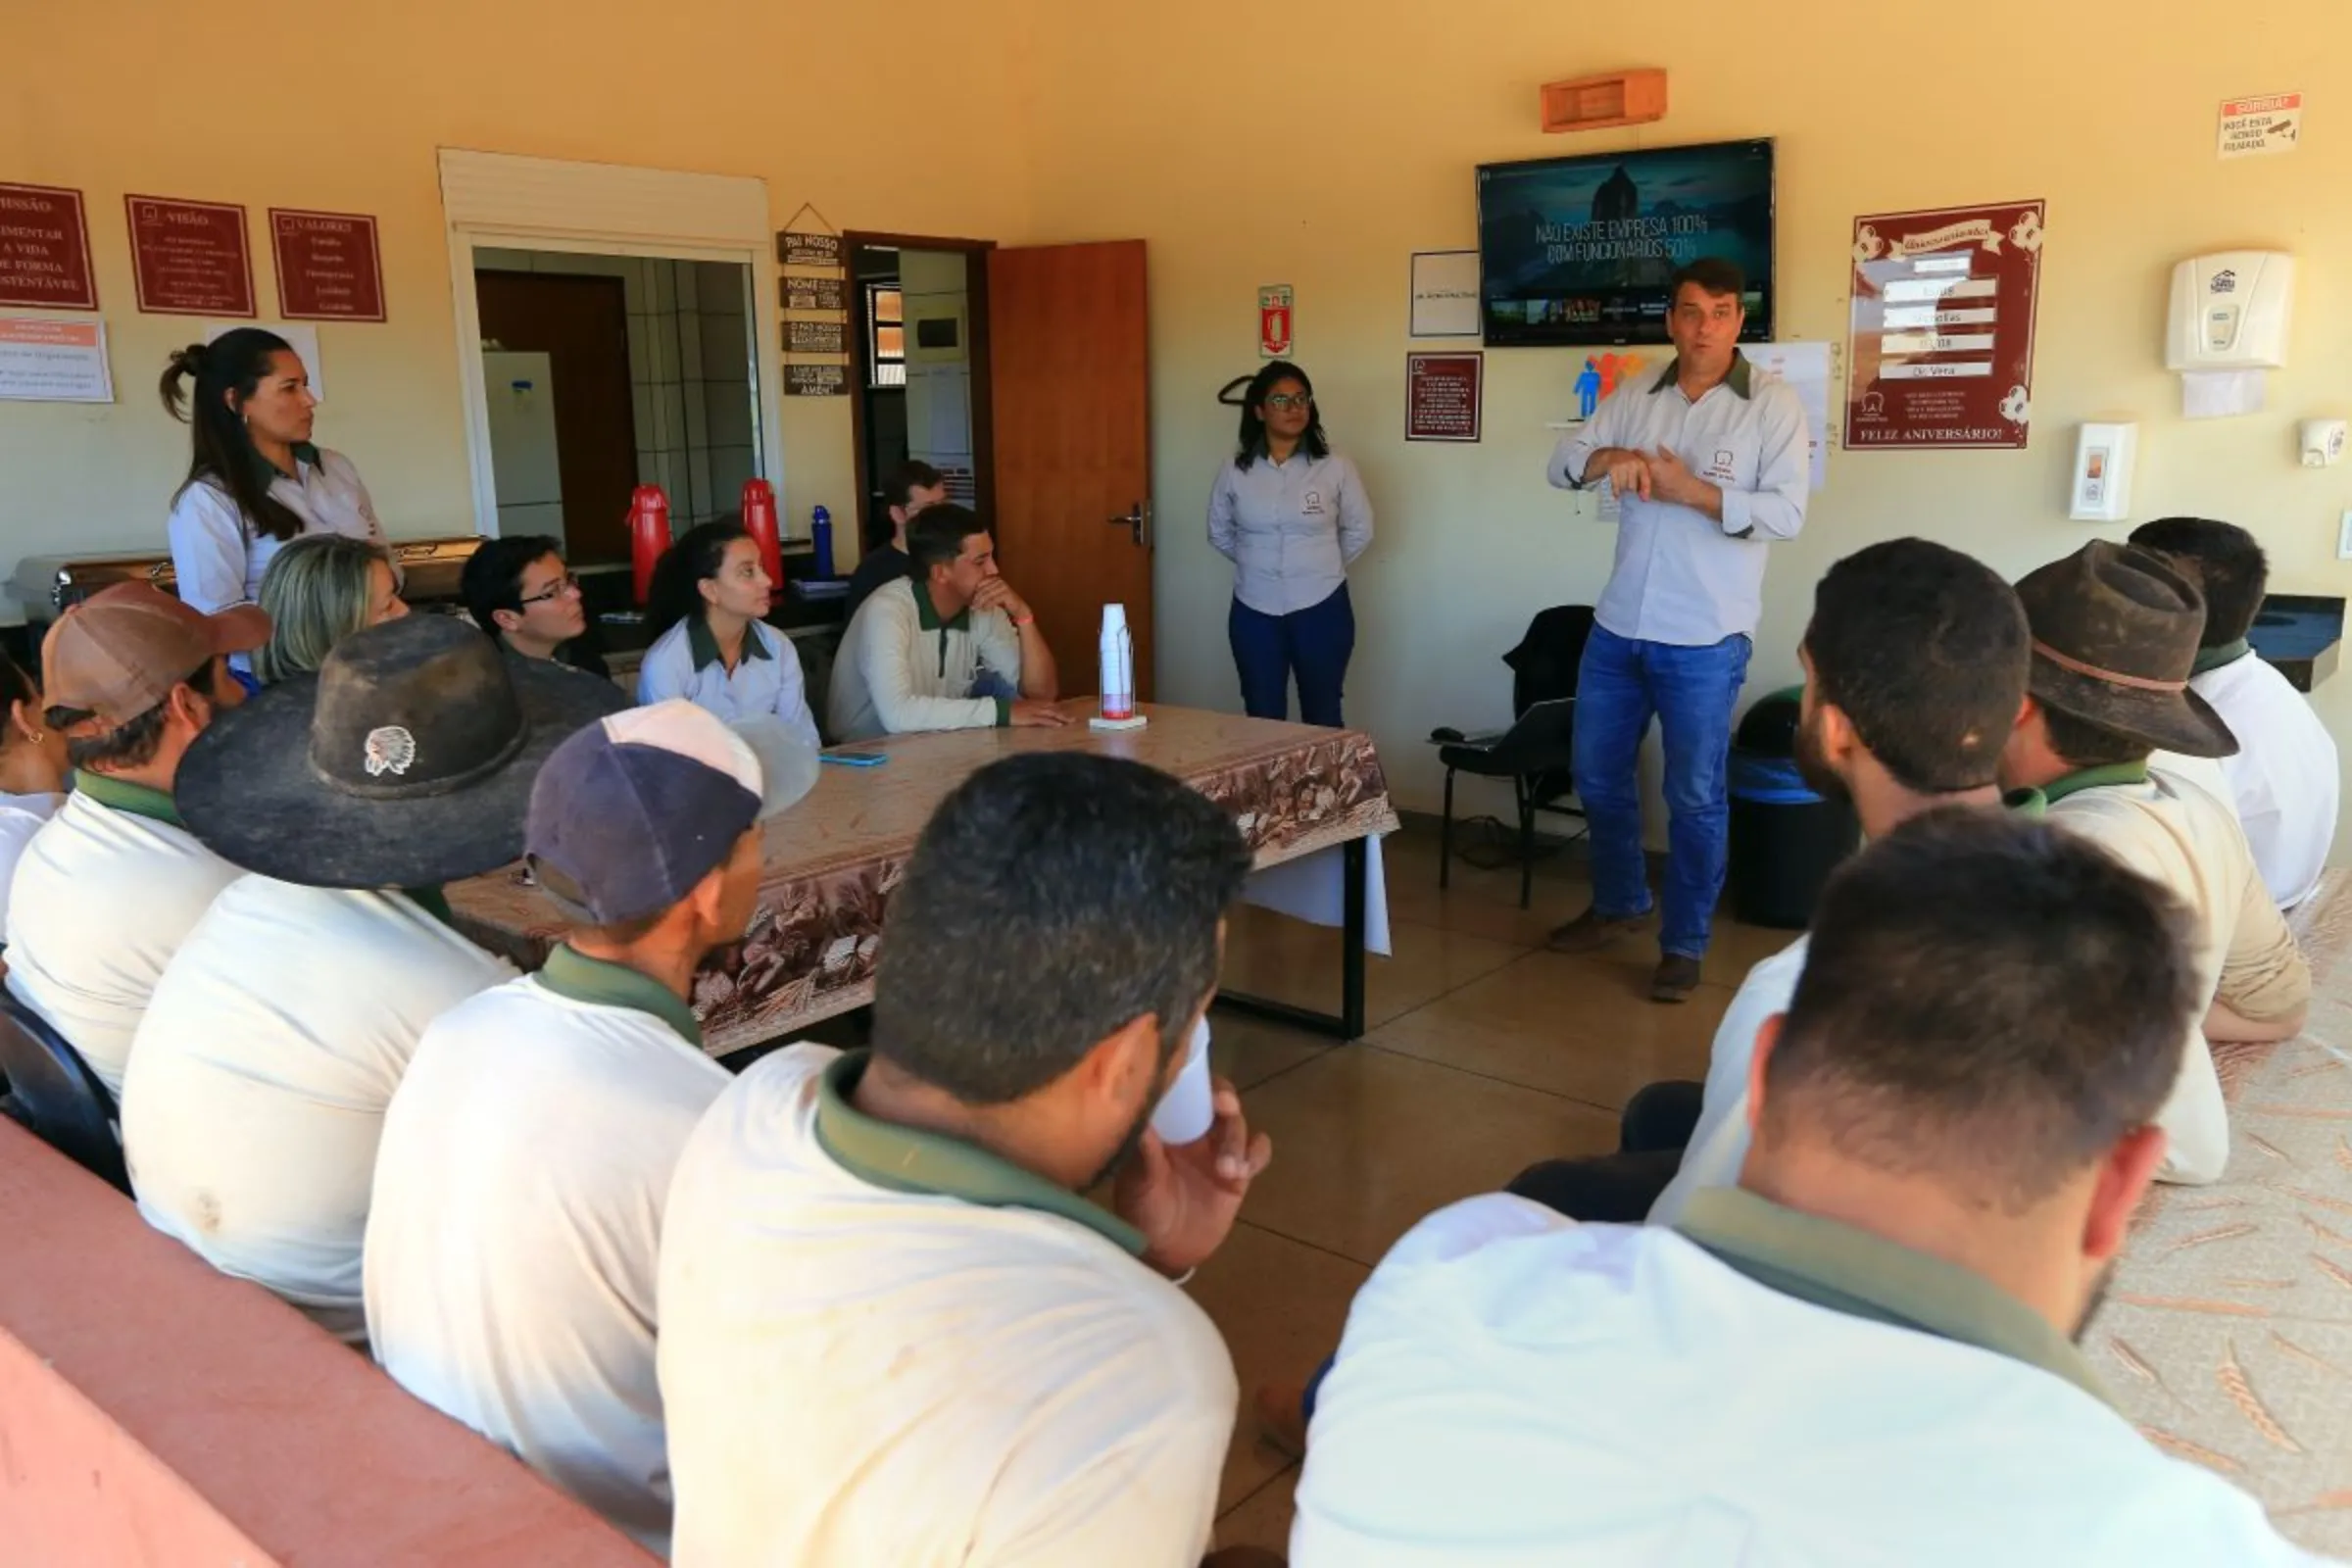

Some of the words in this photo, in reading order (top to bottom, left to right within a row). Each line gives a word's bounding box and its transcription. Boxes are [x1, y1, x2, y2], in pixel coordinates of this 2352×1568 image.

[1563, 220, 1605, 241] EXISTE
[1608, 217, 1667, 240] EMPRESA
[17, 242, 49, 256] VIDA
[1546, 244, 1574, 265] COM
[15, 260, 63, 272] FORMA
[1860, 428, 1898, 440] FELIZ
